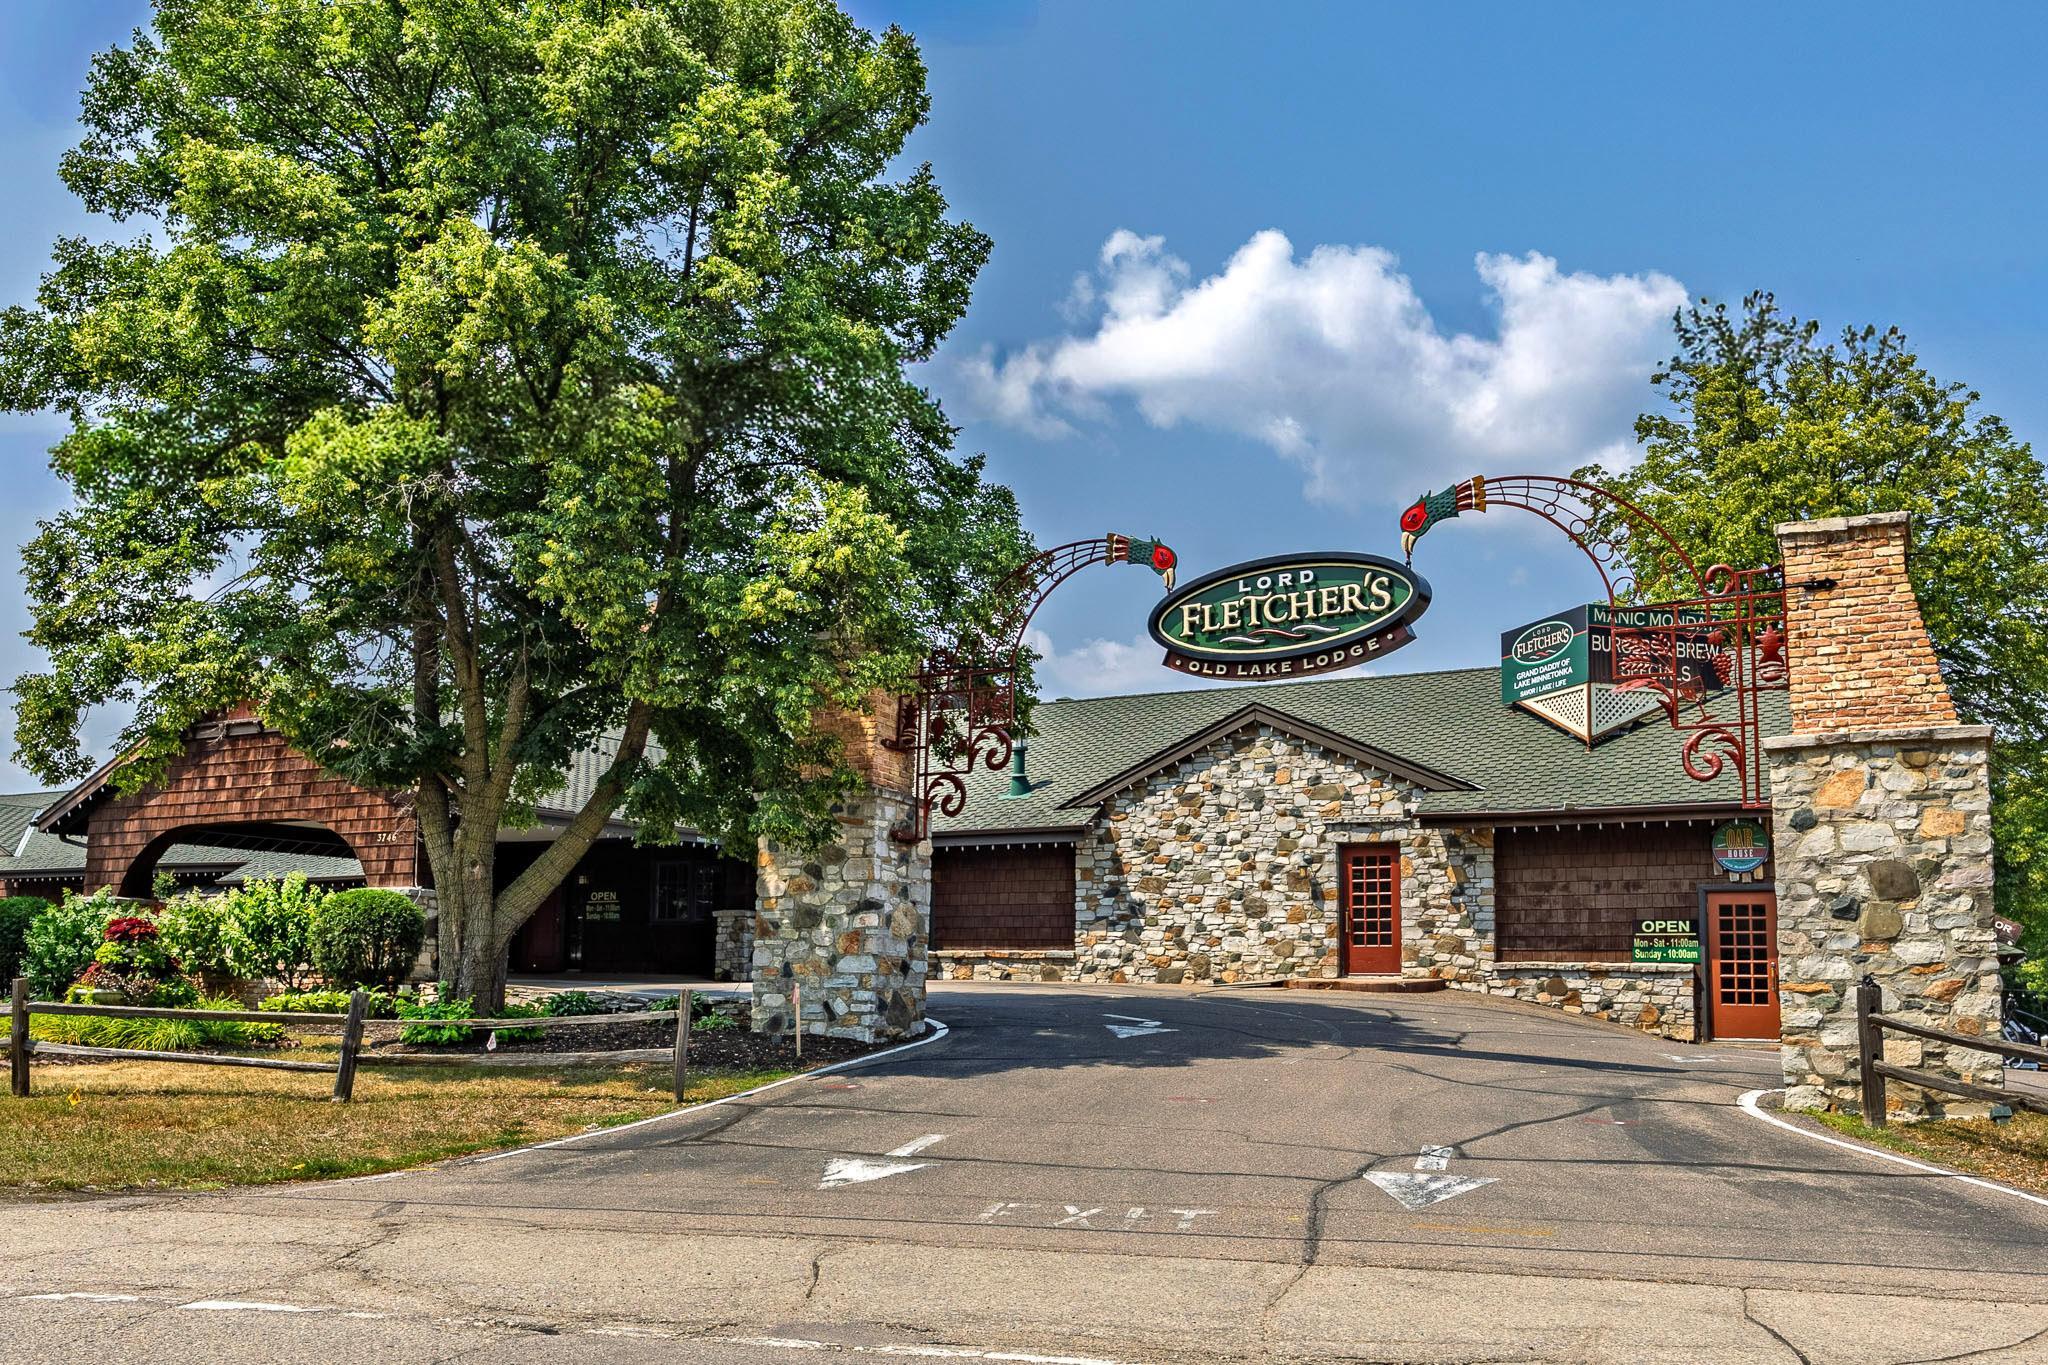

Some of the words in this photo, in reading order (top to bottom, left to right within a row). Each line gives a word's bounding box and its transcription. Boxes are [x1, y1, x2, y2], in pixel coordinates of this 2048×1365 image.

[1238, 570, 1315, 593] LORD
[1179, 571, 1393, 638] FLETCHER'S
[1532, 626, 1551, 637] LORD
[1516, 627, 1570, 658] FLETCHER'S
[1676, 641, 1720, 659] BREW
[1188, 661, 1227, 676] OLD
[1237, 661, 1292, 676] LAKE
[1303, 638, 1380, 670] LODGE
[1513, 678, 1531, 690] LAKE
[1530, 666, 1573, 684] MINNETONKA
[1516, 667, 1539, 680] GRAND
[1539, 661, 1561, 674] DADDY
[1561, 658, 1571, 667] OF
[1539, 683, 1552, 693] LAKE
[1555, 679, 1567, 688] LIFE
[1726, 828, 1753, 849] OAR
[1728, 849, 1754, 858] HOUSE
[590, 891, 617, 901] OPEN
[1641, 920, 1690, 933] OPEN
[1633, 937, 1648, 947] Mon
[1653, 937, 1665, 948] Sat
[1671, 938, 1699, 948] 11:00am
[1635, 949, 1662, 960] Sunday
[1668, 949, 1698, 959] 10:00am
